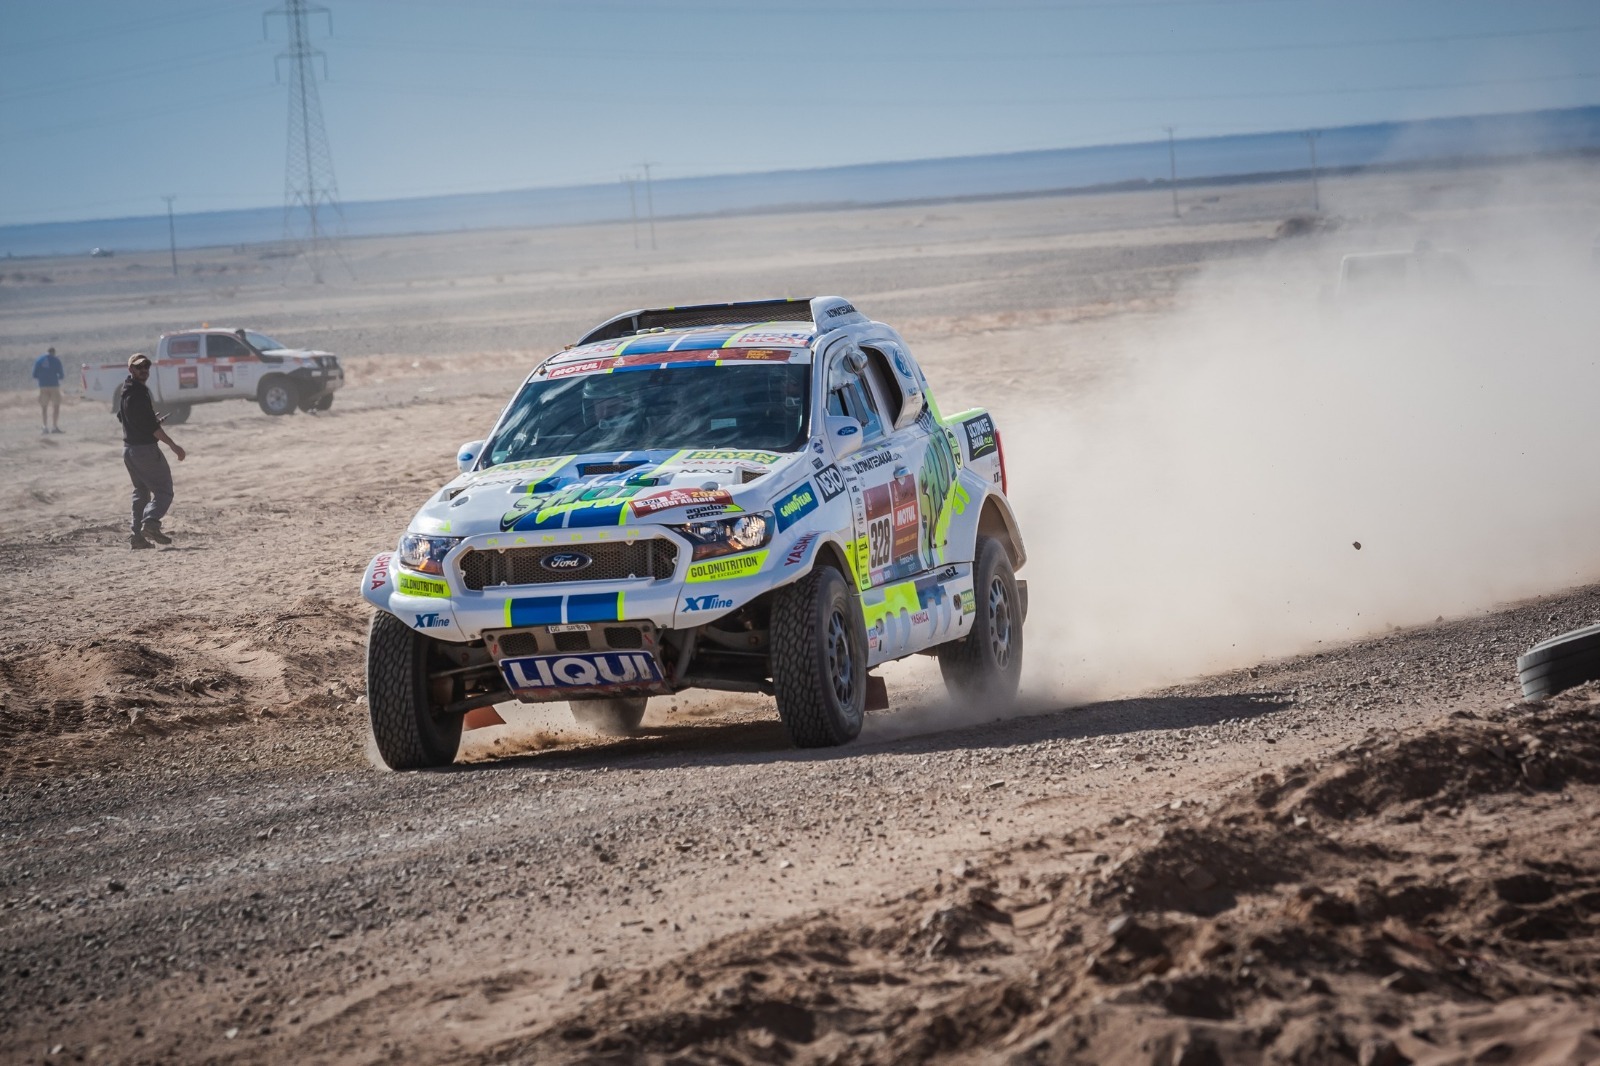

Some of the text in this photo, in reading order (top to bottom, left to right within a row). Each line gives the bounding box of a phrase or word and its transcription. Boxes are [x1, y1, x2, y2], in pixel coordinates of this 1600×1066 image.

[552, 363, 598, 377] MOTUL
[650, 496, 716, 510] SAUDI ARABIA
[686, 504, 728, 515] agados
[780, 492, 813, 517] GOODYEAR
[896, 505, 916, 527] MOTUL
[870, 518, 891, 569] 328
[551, 555, 578, 568] Ford
[690, 556, 759, 578] GOLDNUTRITION
[717, 570, 743, 578] EXCELLENT
[400, 577, 444, 594] GOLDNUTRITION
[681, 594, 733, 612] XTline
[413, 613, 450, 629] XTline
[509, 655, 653, 687] LIQUI
